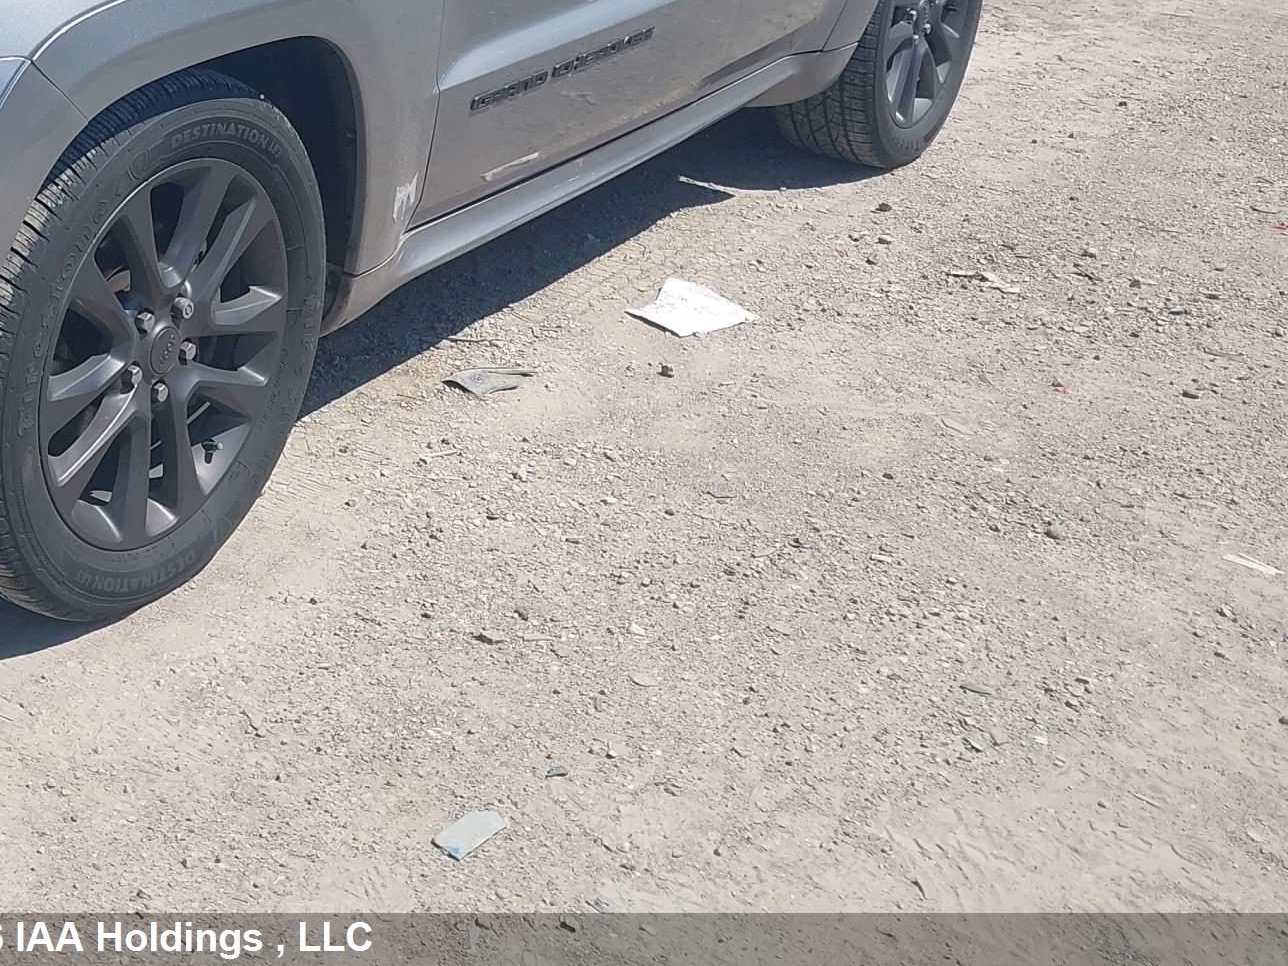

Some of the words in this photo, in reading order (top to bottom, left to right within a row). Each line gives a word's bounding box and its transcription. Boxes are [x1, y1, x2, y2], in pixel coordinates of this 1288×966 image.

[469, 68, 549, 112] GRAND
[550, 25, 656, 79] CHEROKEE
[169, 121, 270, 151] DESTINATION
